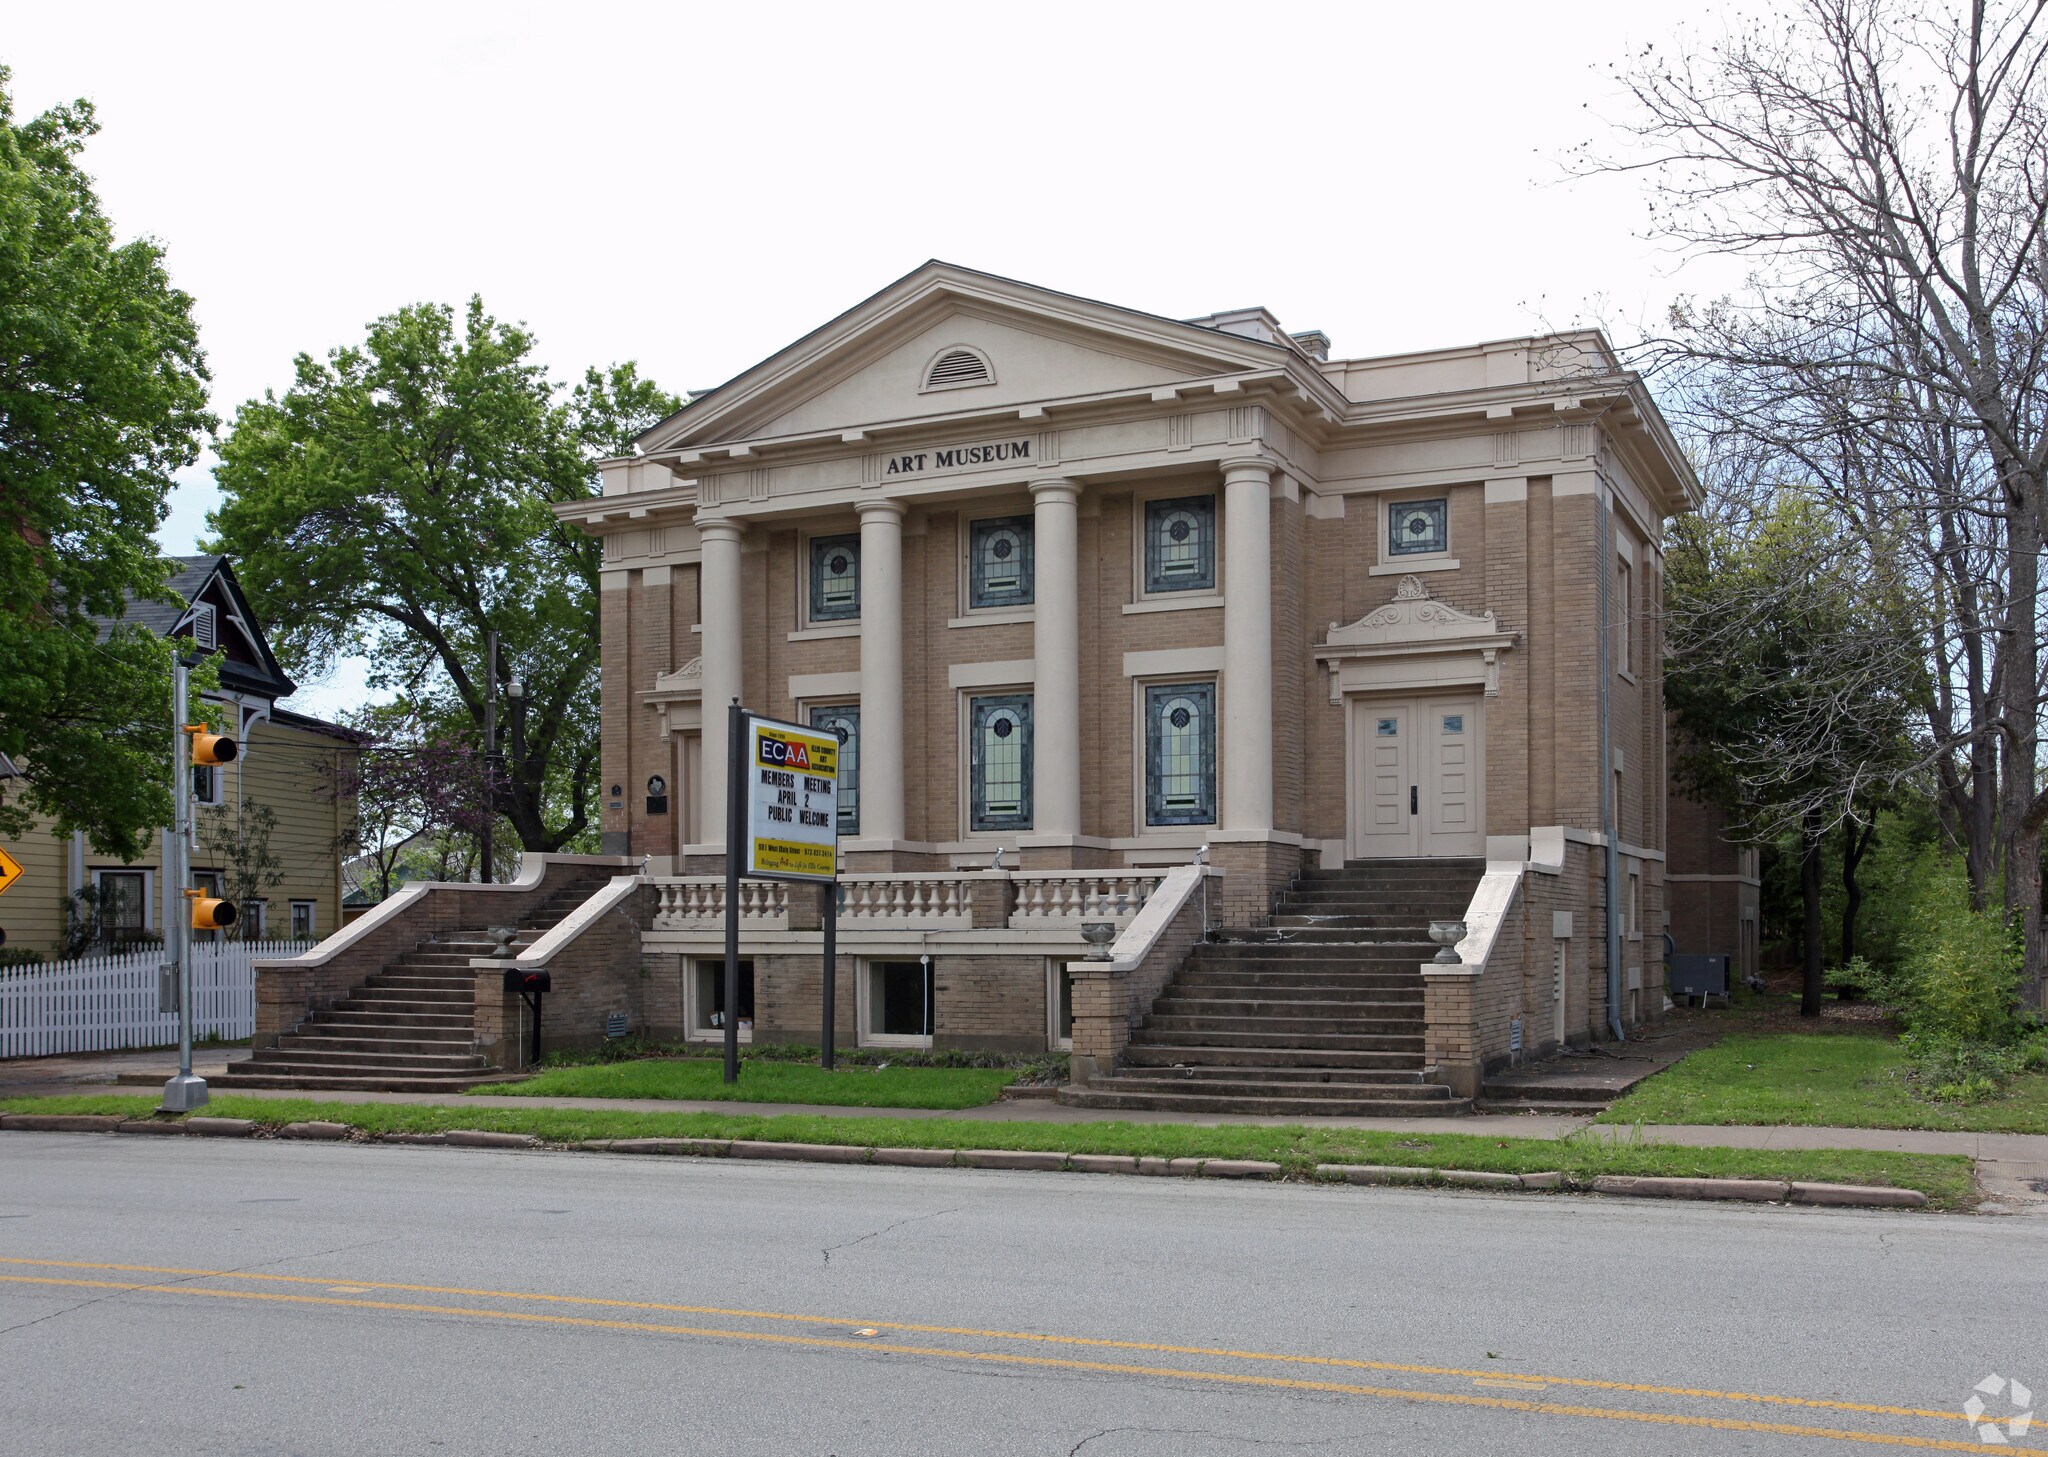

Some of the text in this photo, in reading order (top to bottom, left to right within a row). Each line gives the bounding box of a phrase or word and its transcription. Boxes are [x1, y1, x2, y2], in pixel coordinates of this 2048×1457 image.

[887, 440, 1030, 474] ART MUSEUM
[762, 740, 808, 764] ECAA
[811, 744, 835, 756] ELLIS COUNTY
[812, 763, 835, 773] ASSOCIATION
[761, 770, 831, 794] MEMBERS MEETING
[778, 790, 809, 808] APRIL 2
[768, 806, 829, 827] PUBLIC WELCOME
[817, 864, 830, 872] County
